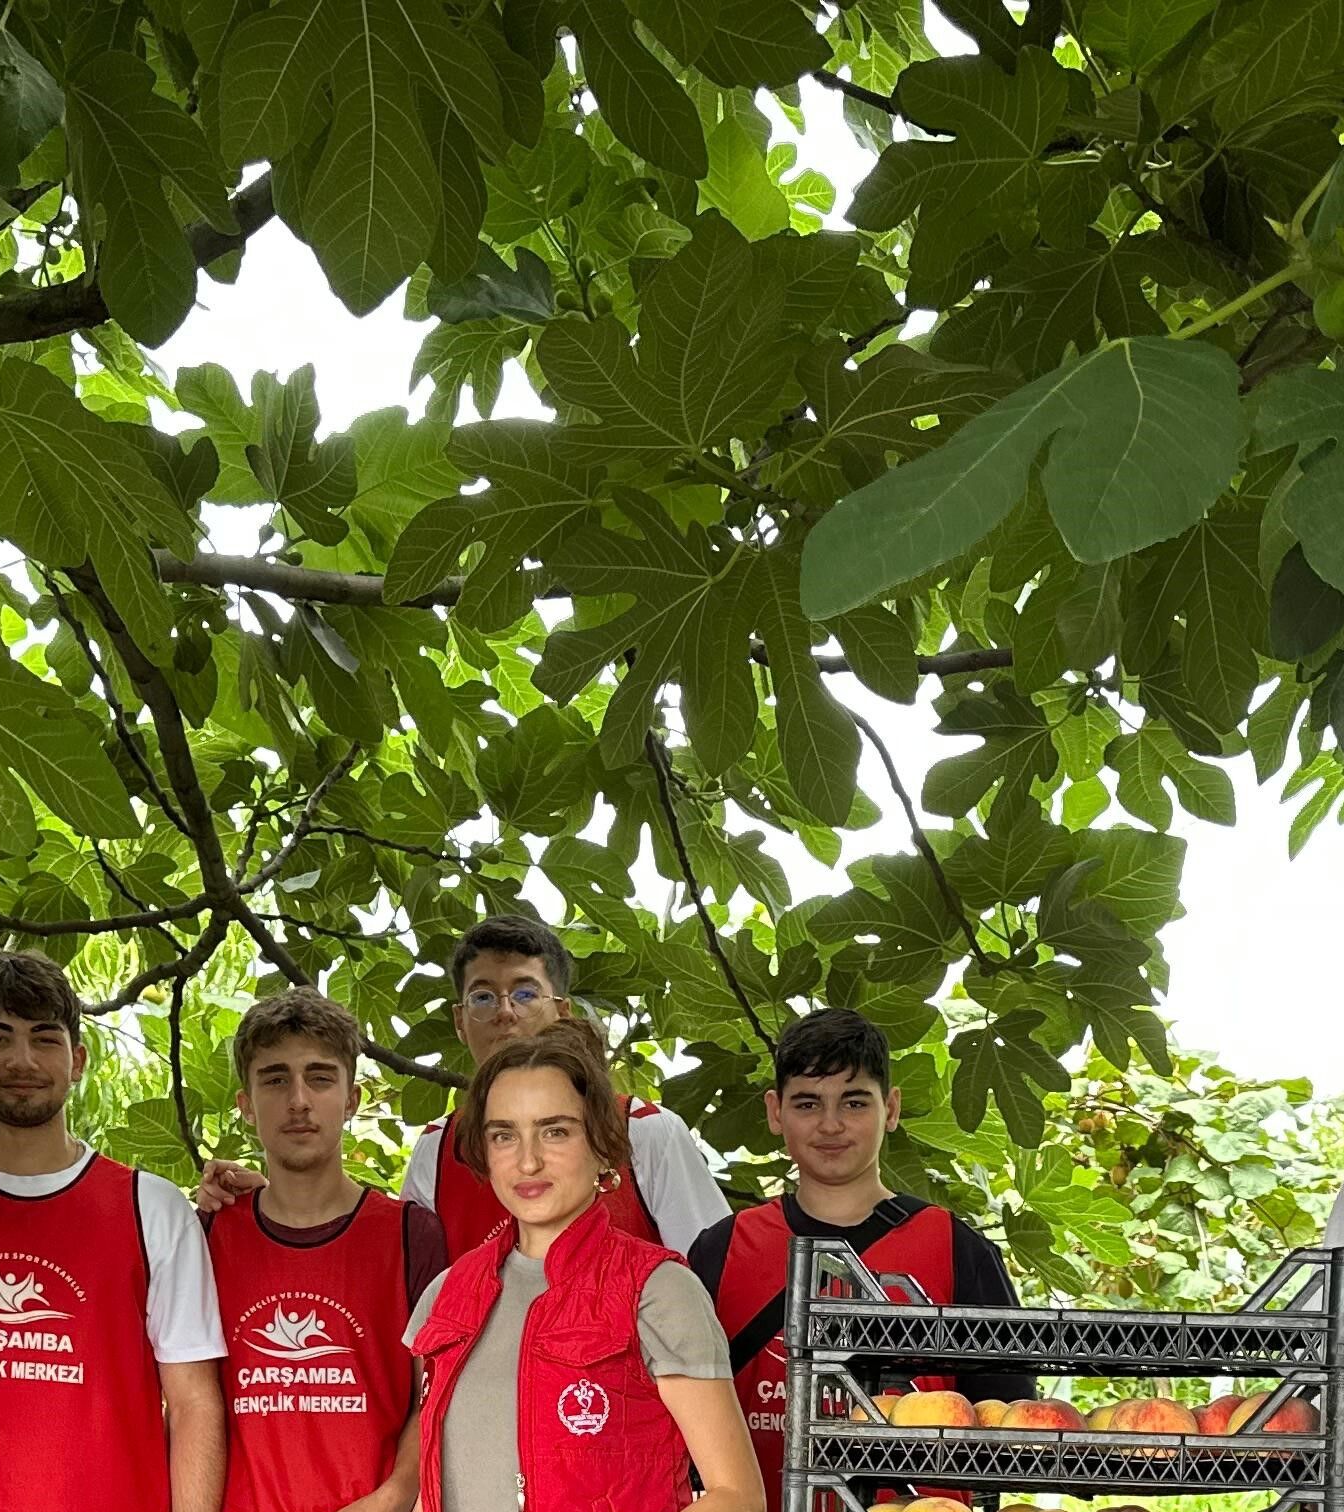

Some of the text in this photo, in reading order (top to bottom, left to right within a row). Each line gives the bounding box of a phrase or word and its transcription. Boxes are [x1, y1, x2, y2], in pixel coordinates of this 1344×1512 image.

[12, 1252, 40, 1264] SPOR
[10, 1360, 84, 1385] MERKEZİ
[237, 1366, 357, 1389] ÇARŞAMBA
[233, 1391, 368, 1416] GENÇLİK MERKEZİ
